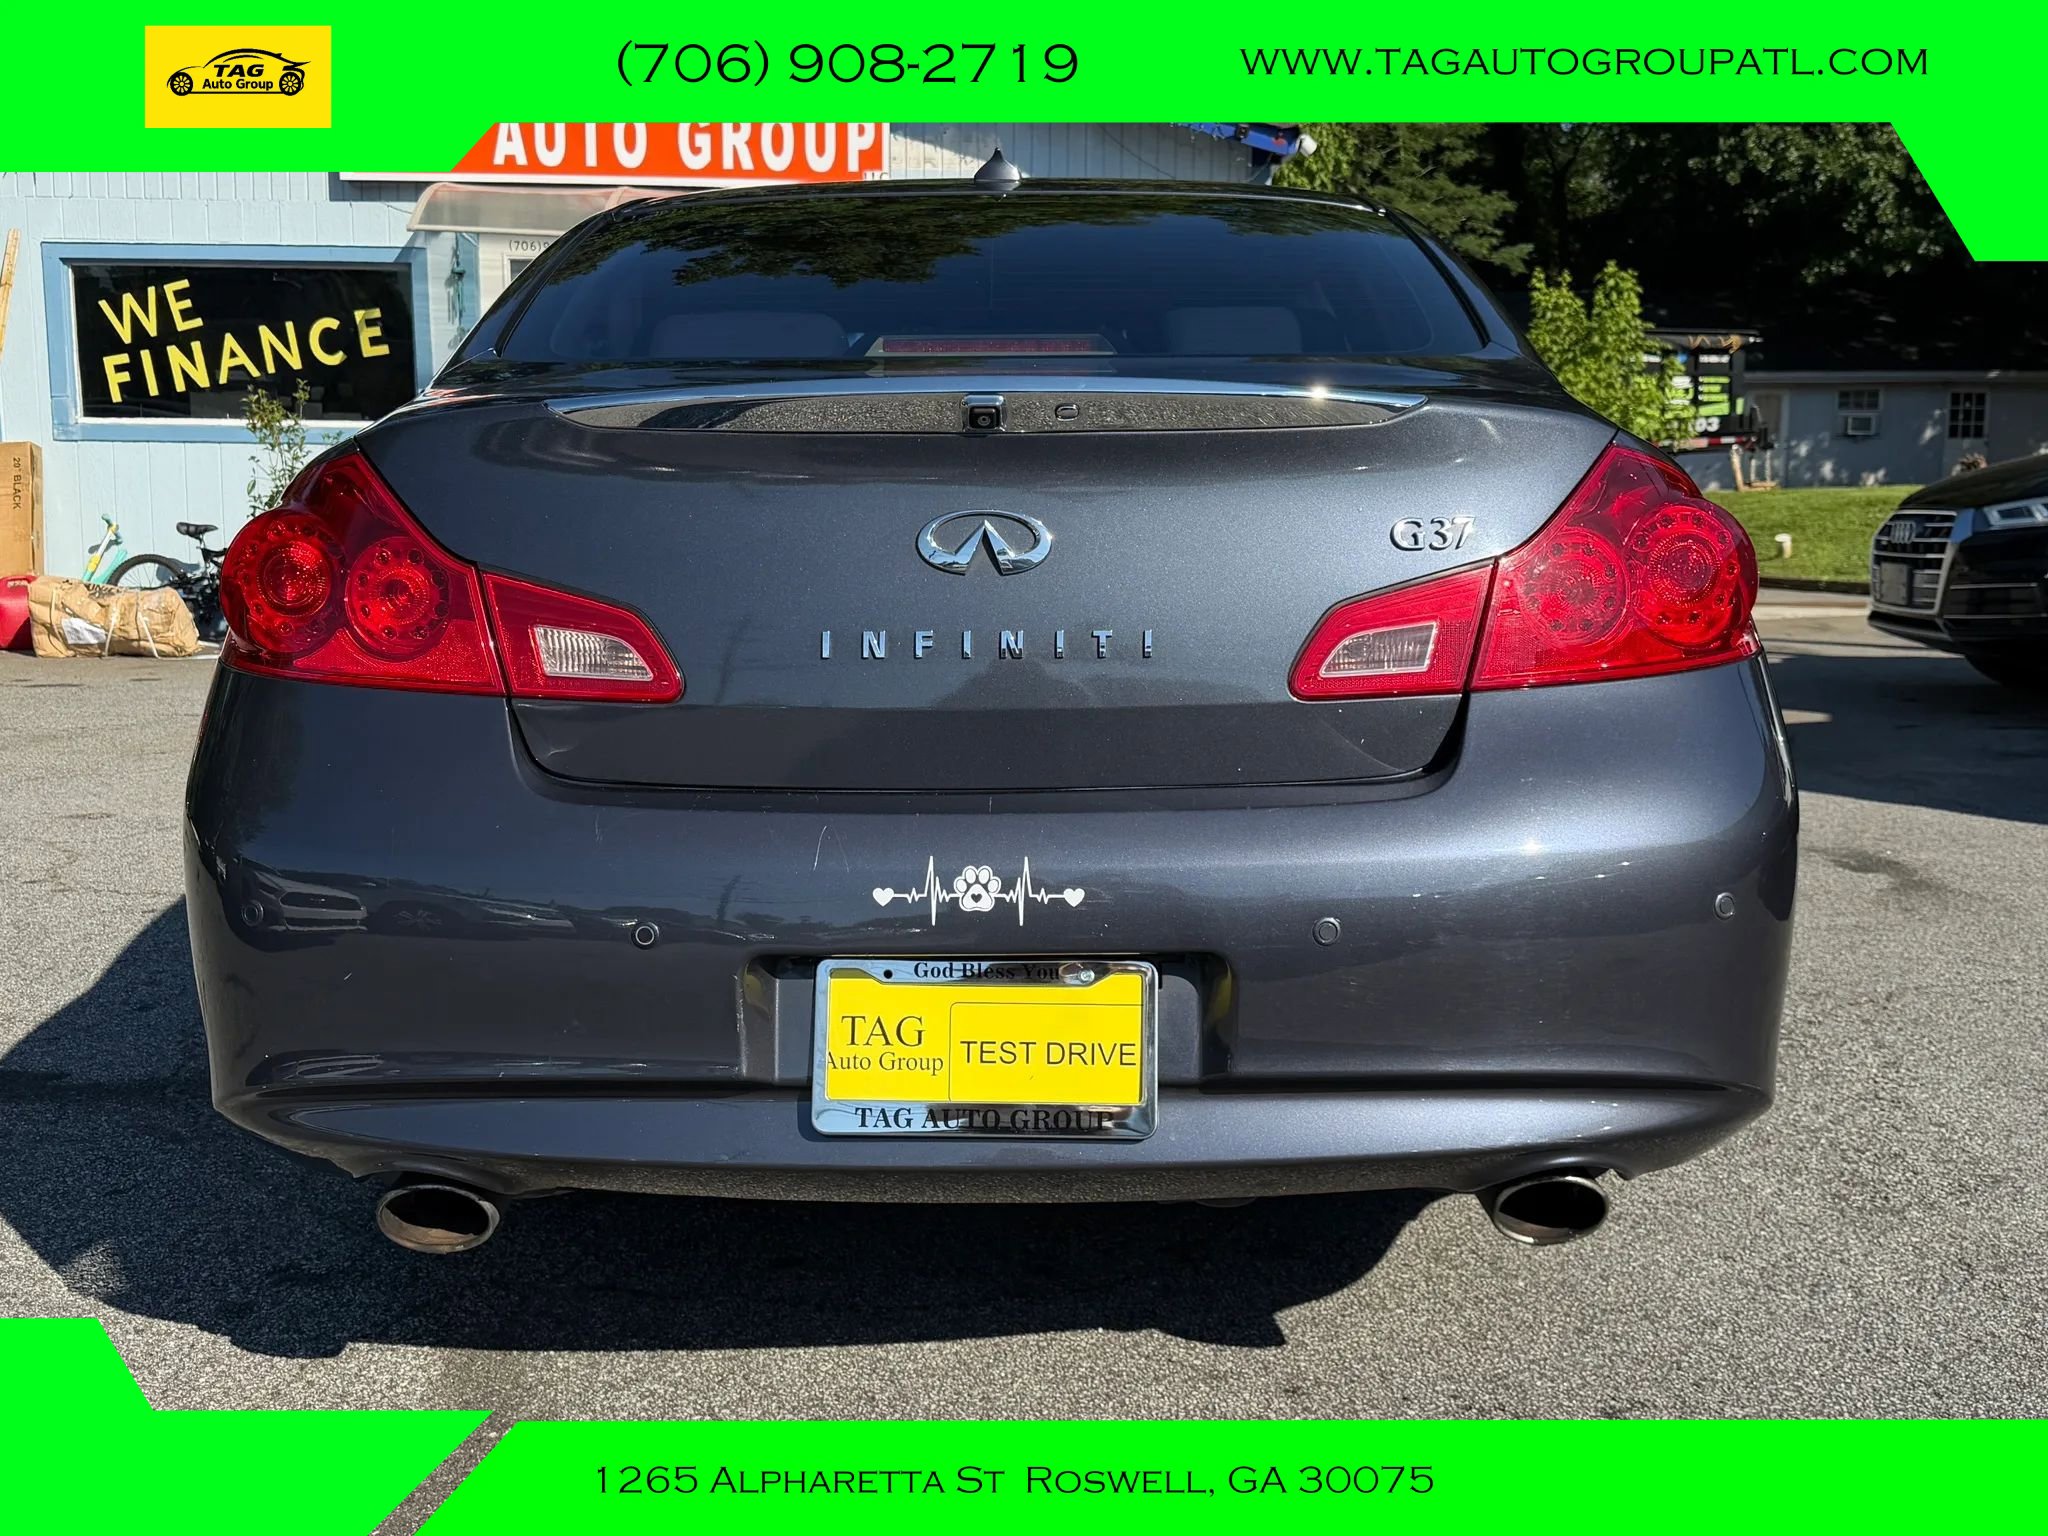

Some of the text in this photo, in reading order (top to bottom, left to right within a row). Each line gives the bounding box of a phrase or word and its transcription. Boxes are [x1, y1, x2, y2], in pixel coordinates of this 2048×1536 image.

[678, 123, 876, 173] GROUP
[98, 278, 204, 345] WE
[103, 307, 391, 404] FINANCE
[12, 474, 22, 510] BLACK
[1389, 515, 1476, 552] G37
[821, 629, 1153, 660] INFINITI
[913, 961, 1060, 981] God Bless You
[841, 1015, 926, 1047] TAG
[828, 1051, 945, 1077] Auto Group
[960, 1040, 1137, 1067] TEST DRIVE
[855, 1107, 1115, 1134] TAG AUTO GROUP
